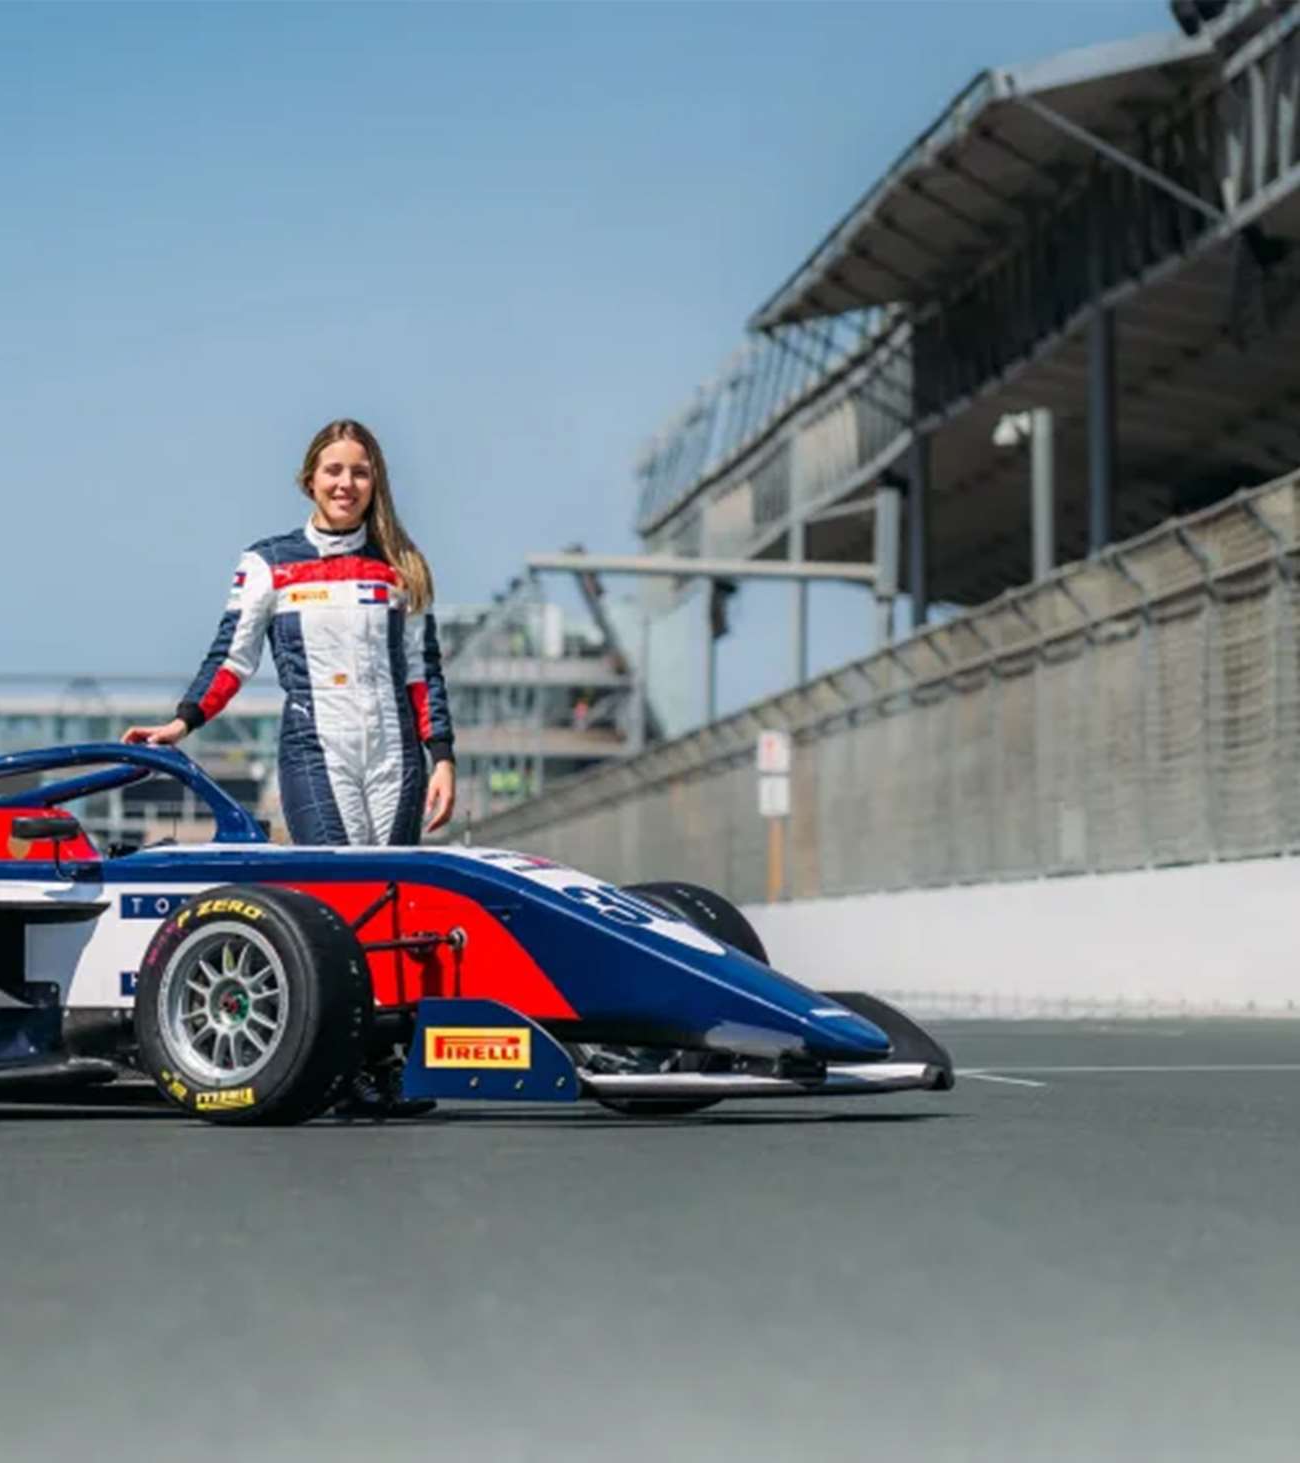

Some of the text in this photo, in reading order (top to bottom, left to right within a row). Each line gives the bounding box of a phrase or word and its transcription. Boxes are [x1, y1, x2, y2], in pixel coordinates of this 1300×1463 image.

[132, 897, 188, 914] TO
[197, 899, 267, 921] ZERO
[560, 884, 690, 925] 30
[434, 1036, 520, 1060] PIRELLI
